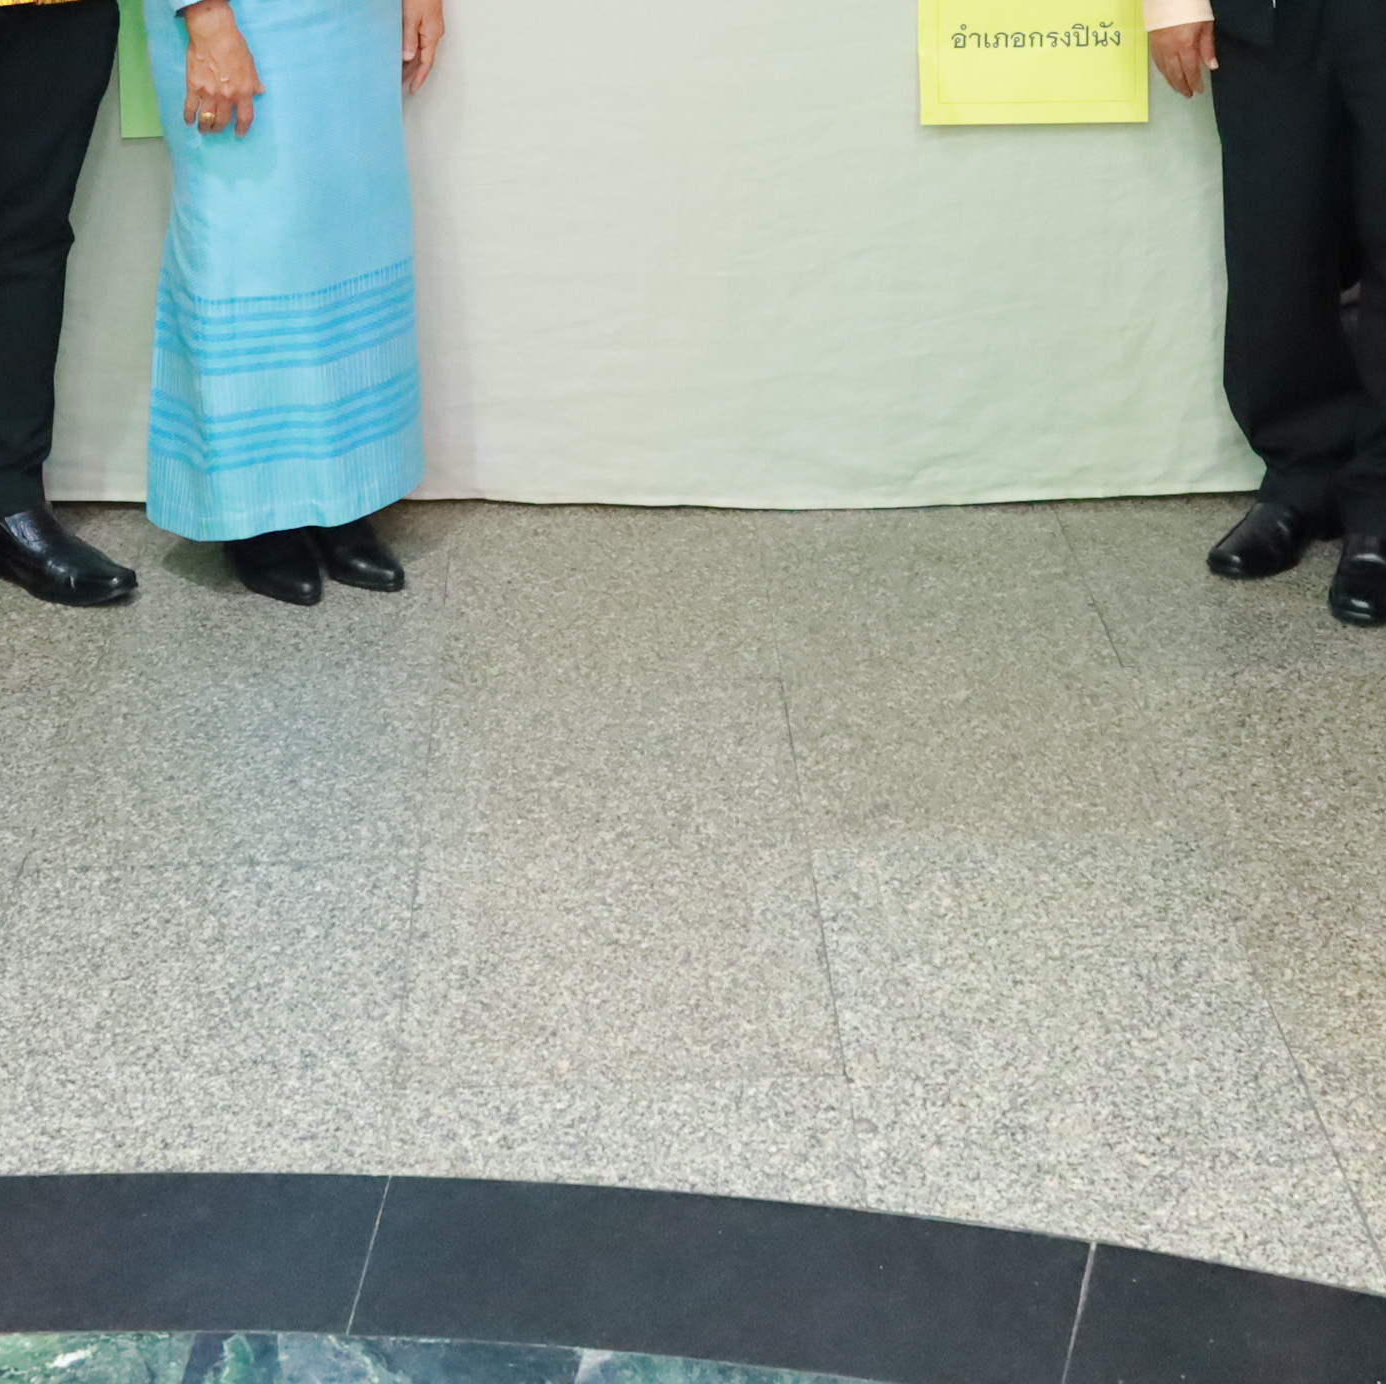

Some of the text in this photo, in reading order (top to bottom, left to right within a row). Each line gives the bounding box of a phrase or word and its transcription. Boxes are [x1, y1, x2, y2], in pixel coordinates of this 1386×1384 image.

[951, 21, 1123, 50] อำเภอกรงปินัง
